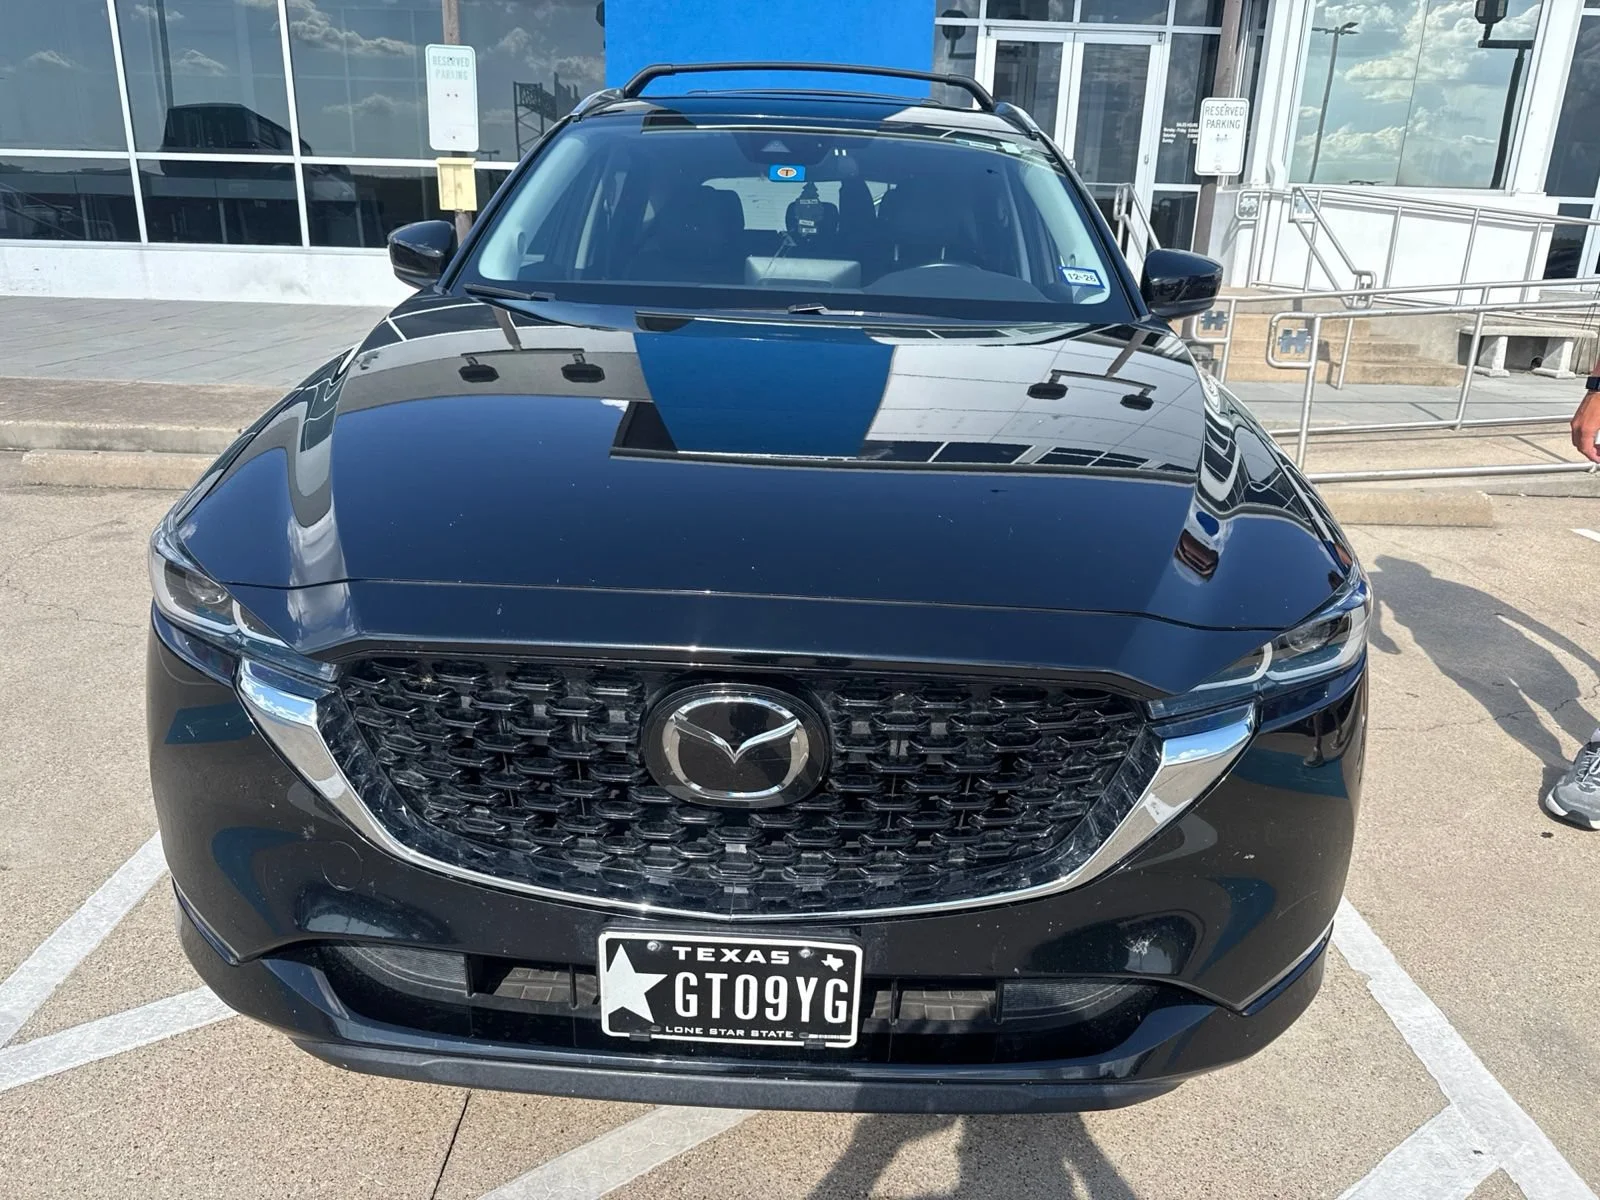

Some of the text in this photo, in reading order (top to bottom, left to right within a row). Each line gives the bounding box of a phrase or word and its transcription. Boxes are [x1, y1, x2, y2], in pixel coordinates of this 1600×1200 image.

[432, 55, 470, 68] RESERVED
[1205, 106, 1245, 117] RESERVED
[1206, 119, 1241, 130] PARKING
[672, 945, 790, 965] TEXAS
[665, 1025, 794, 1039] LONE STAR STATE
